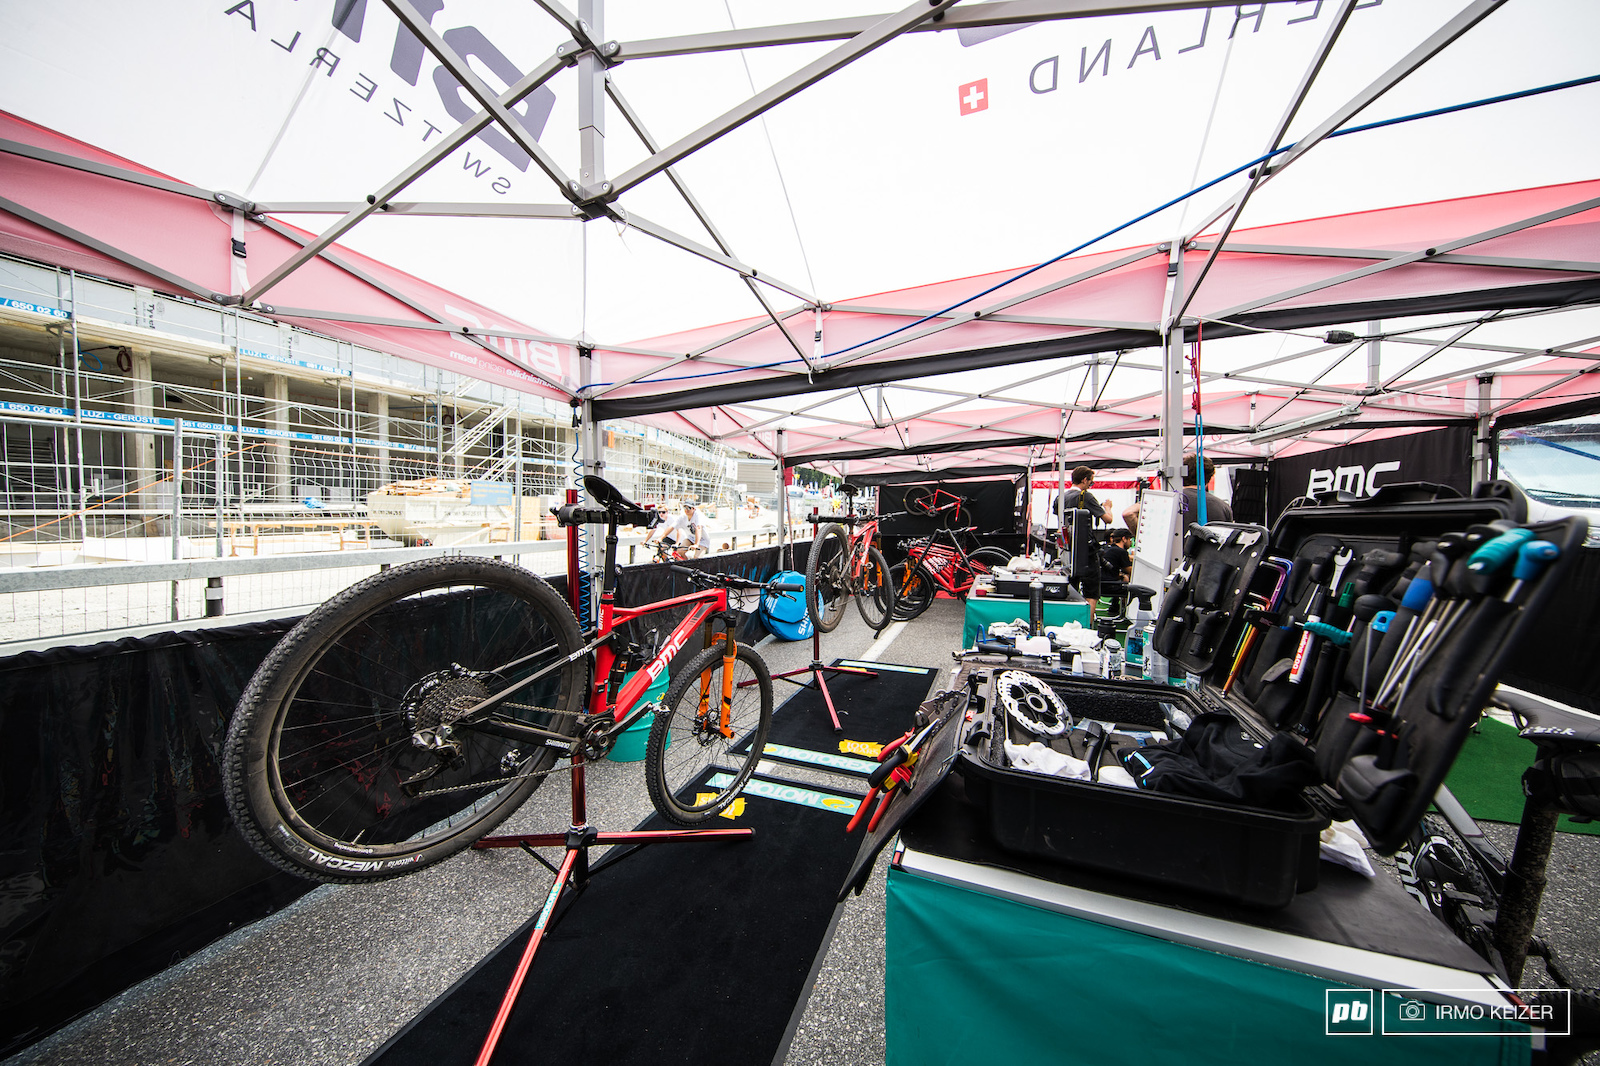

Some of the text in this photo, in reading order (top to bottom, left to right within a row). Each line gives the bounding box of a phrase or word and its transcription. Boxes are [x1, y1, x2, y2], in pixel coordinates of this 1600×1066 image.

[12, 301, 34, 312] 650
[36, 305, 51, 315] 02
[53, 308, 68, 318] 60
[6, 402, 30, 412] 650
[33, 405, 46, 413] 02
[48, 407, 63, 415] 60
[81, 410, 104, 419] LUZI
[241, 426, 258, 434] LUZI
[1306, 461, 1400, 499] BMC
[597, 608, 605, 630] BMC
[568, 645, 594, 661] BMC
[646, 630, 688, 682] BMC
[545, 738, 571, 749] SHIMANO
[846, 742, 869, 750] 100
[778, 748, 876, 772] MOTOREX
[719, 775, 820, 804] MOTORX
[308, 848, 384, 872] MEZCAL
